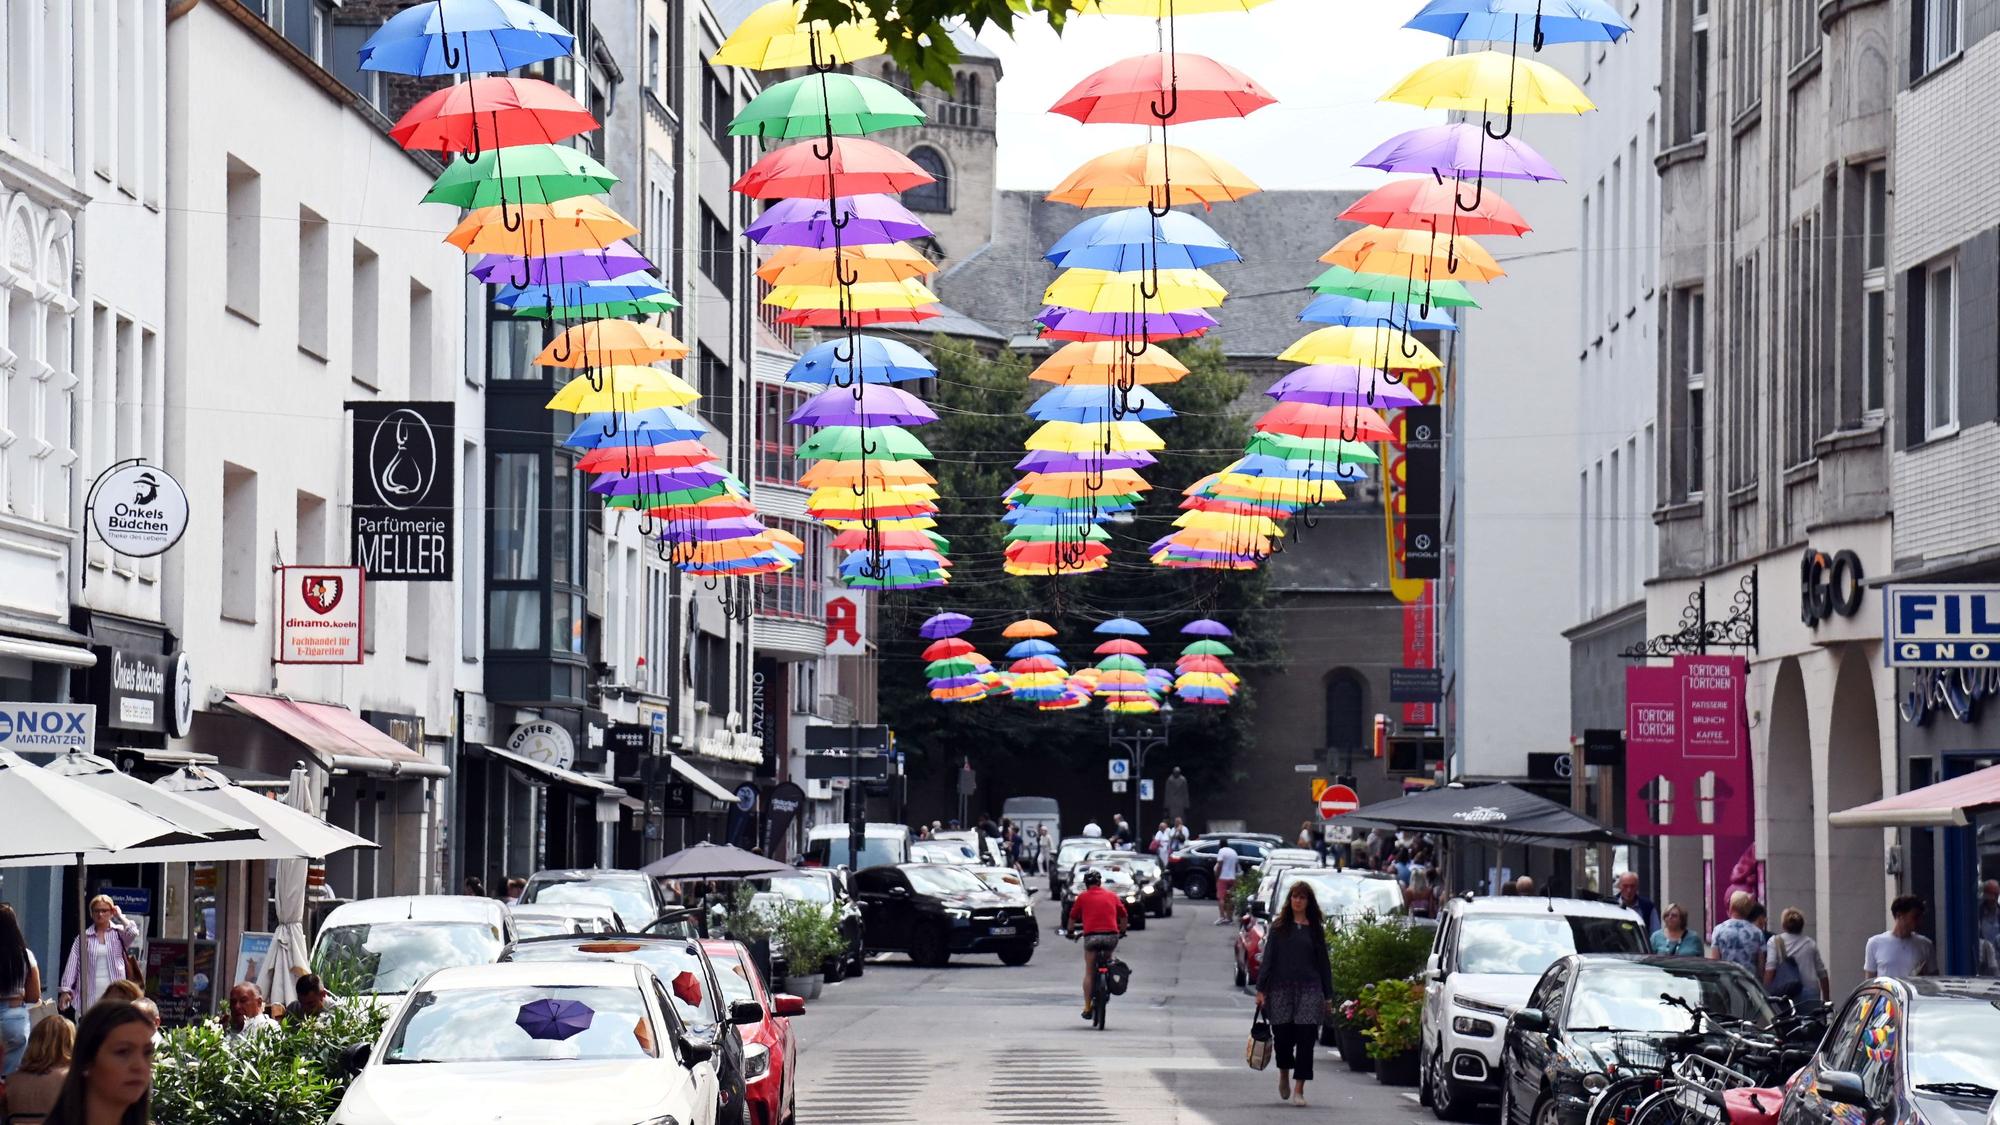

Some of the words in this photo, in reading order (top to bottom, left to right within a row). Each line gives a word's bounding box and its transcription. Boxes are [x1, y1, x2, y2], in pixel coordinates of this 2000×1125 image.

[115, 503, 164, 519] Onkels
[108, 516, 168, 531] Büdchen
[358, 517, 445, 533] Parfümerie
[358, 534, 445, 573] MELLER
[286, 618, 357, 628] dinamo.koeln
[291, 636, 337, 646] Fachhandel
[338, 636, 351, 646] für
[297, 647, 345, 656] E-Zigaretten
[113, 650, 135, 691] Onkels
[135, 660, 164, 695] Büdchen
[1691, 701, 1728, 709] PATISSERIE
[16, 711, 86, 734] NOX
[1693, 716, 1725, 724] BRUNCH
[16, 735, 86, 745] MATRATZEN
[512, 724, 553, 749] COFFEE
[1696, 731, 1723, 739] KAFFEE
